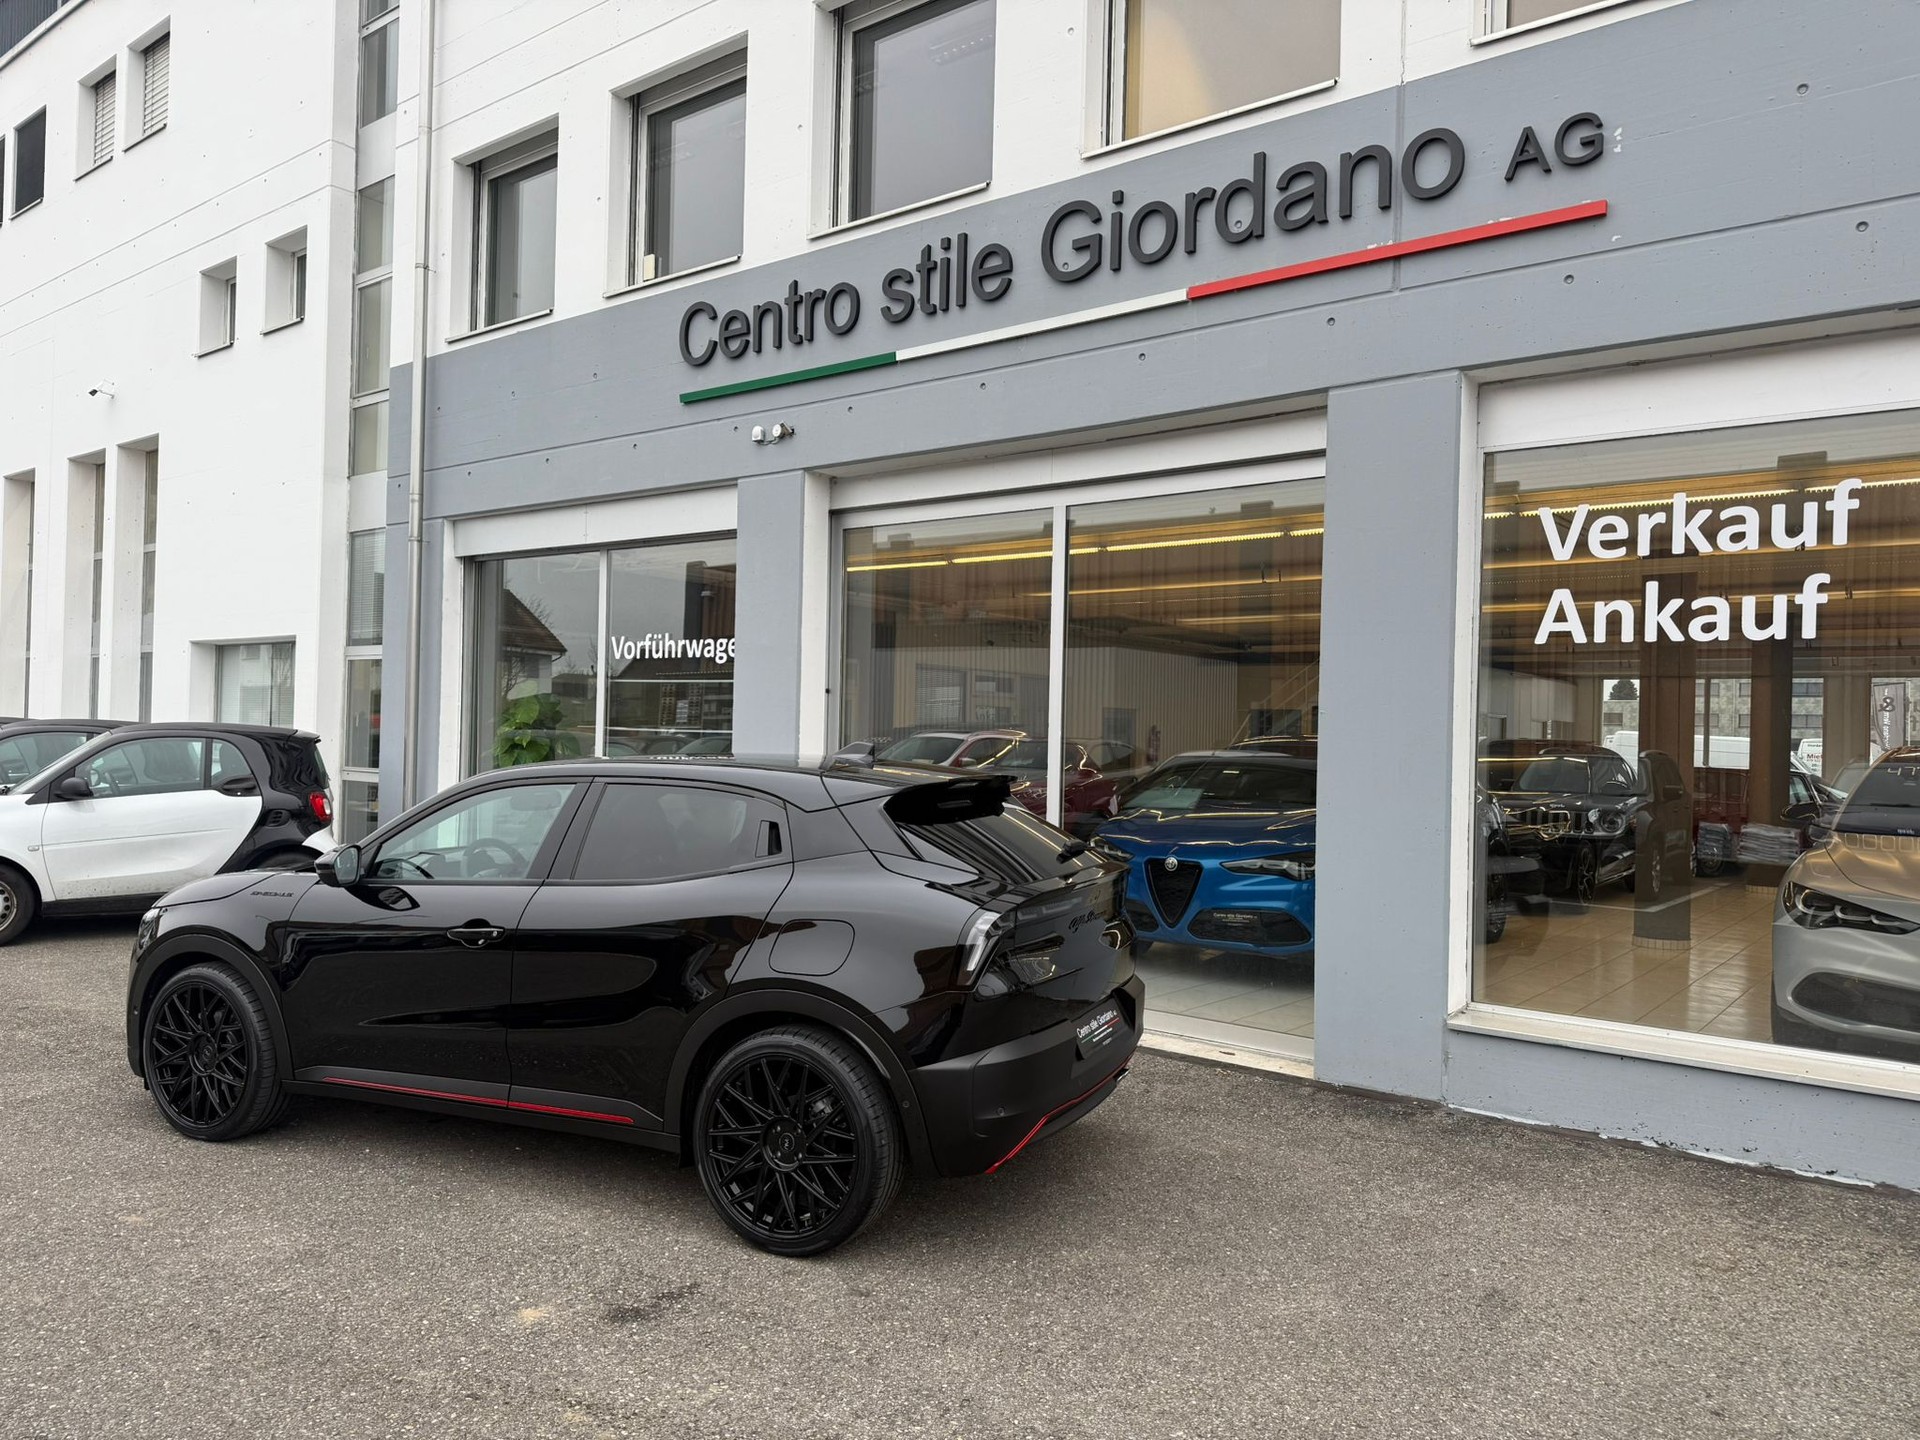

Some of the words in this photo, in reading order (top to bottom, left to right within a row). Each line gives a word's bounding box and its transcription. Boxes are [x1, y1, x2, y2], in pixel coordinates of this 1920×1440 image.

[680, 279, 861, 366] Centro
[880, 232, 1014, 323] stile
[1041, 127, 1466, 282] Giordano
[1504, 112, 1604, 182] AG
[1538, 478, 1862, 561] Verkauf
[1534, 573, 1831, 644] Ankauf
